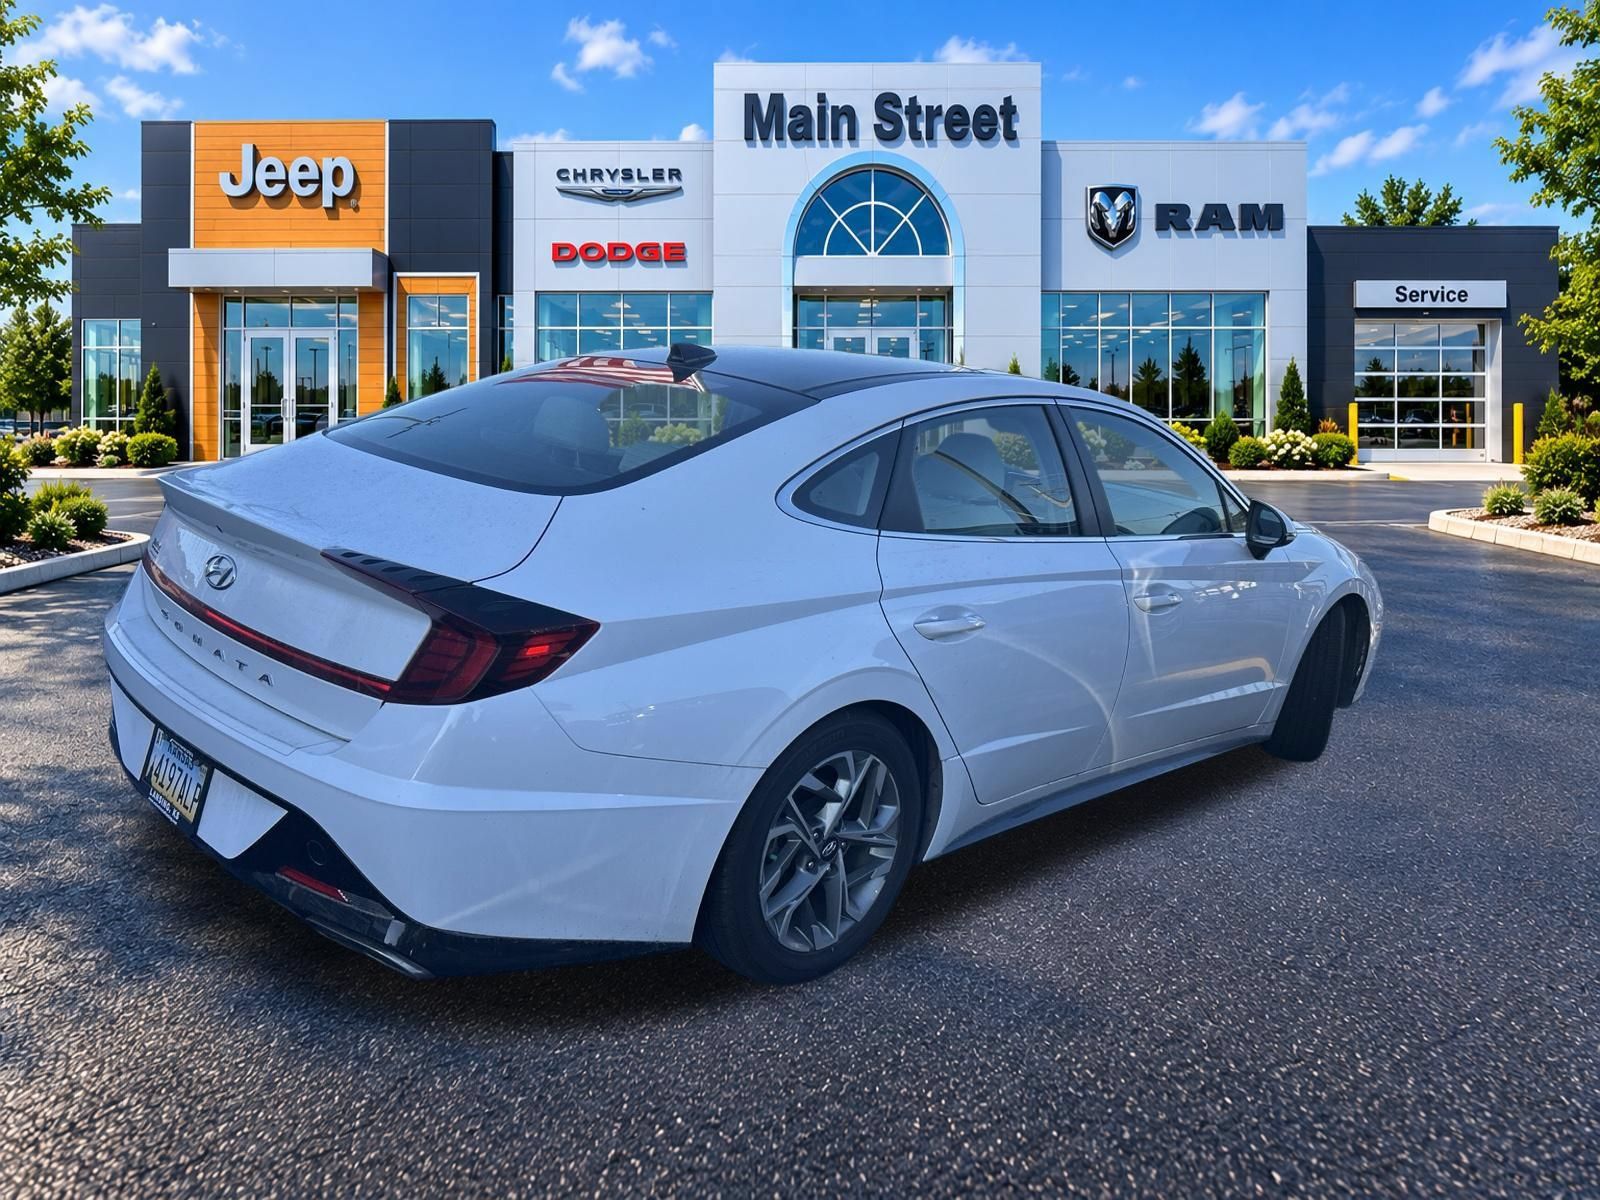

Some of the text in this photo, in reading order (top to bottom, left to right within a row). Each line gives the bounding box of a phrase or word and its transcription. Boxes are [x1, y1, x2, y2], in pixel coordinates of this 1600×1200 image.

[744, 91, 1018, 141] Main Street
[219, 143, 355, 208] Jeep
[556, 168, 683, 182] CHRYSLER
[1155, 203, 1285, 231] RAM
[552, 242, 687, 262] DODGE
[1395, 285, 1469, 303] Service
[161, 609, 274, 687] SONATA
